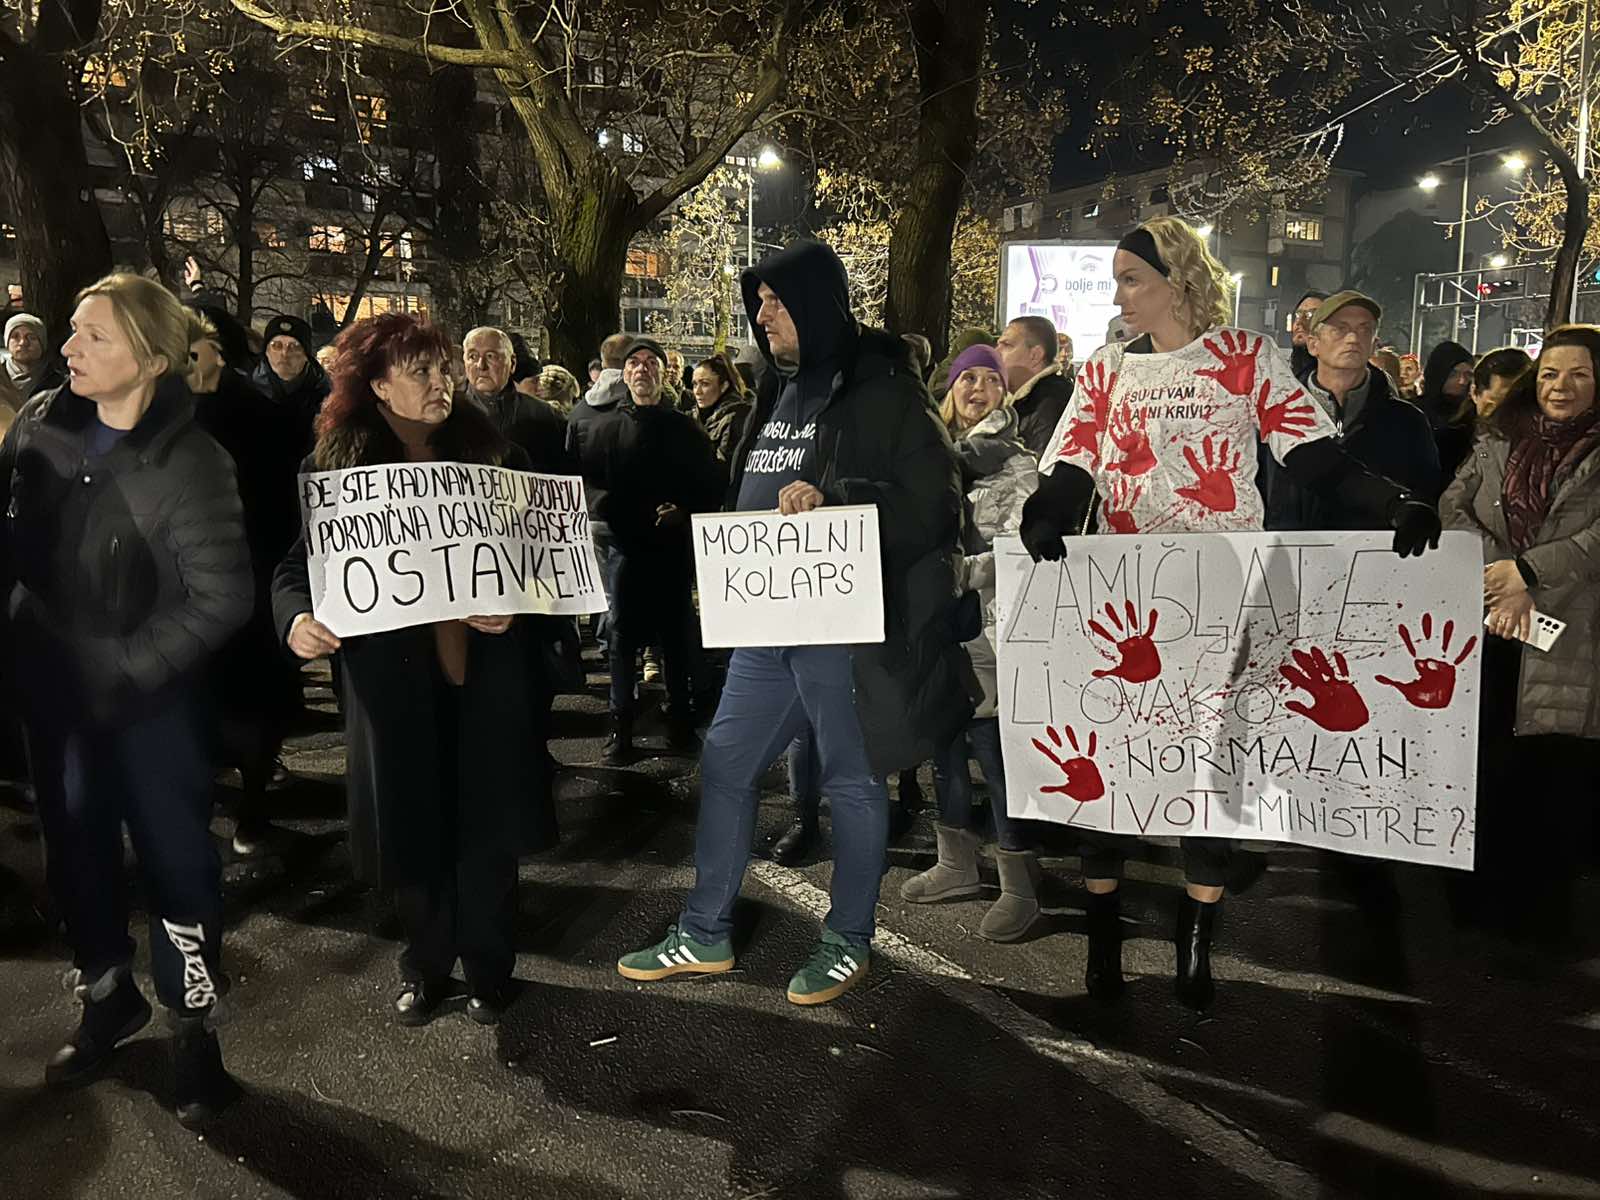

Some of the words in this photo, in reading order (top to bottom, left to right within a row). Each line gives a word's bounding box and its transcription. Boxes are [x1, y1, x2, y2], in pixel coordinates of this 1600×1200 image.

[1165, 404, 1212, 420] KRIVI?
[1167, 386, 1195, 400] VAM
[302, 477, 336, 509] ĐE
[342, 470, 380, 503] STE
[386, 466, 429, 500] KAD
[431, 465, 475, 498] NAM
[478, 466, 517, 504] ĐECU
[305, 522, 315, 556] I
[318, 502, 433, 555] PORODIČNA
[523, 508, 589, 544] GASE???
[702, 513, 865, 557] MORALNI
[343, 542, 595, 614] OSTAVKE!!!
[724, 561, 855, 604] KOLAPS
[1012, 661, 1053, 724] LI
[1079, 677, 1275, 727] OVAKO
[1126, 734, 1407, 779] NORMALAN
[1257, 788, 1466, 855] MINISTRE?
[161, 917, 218, 1009] LAKERS
